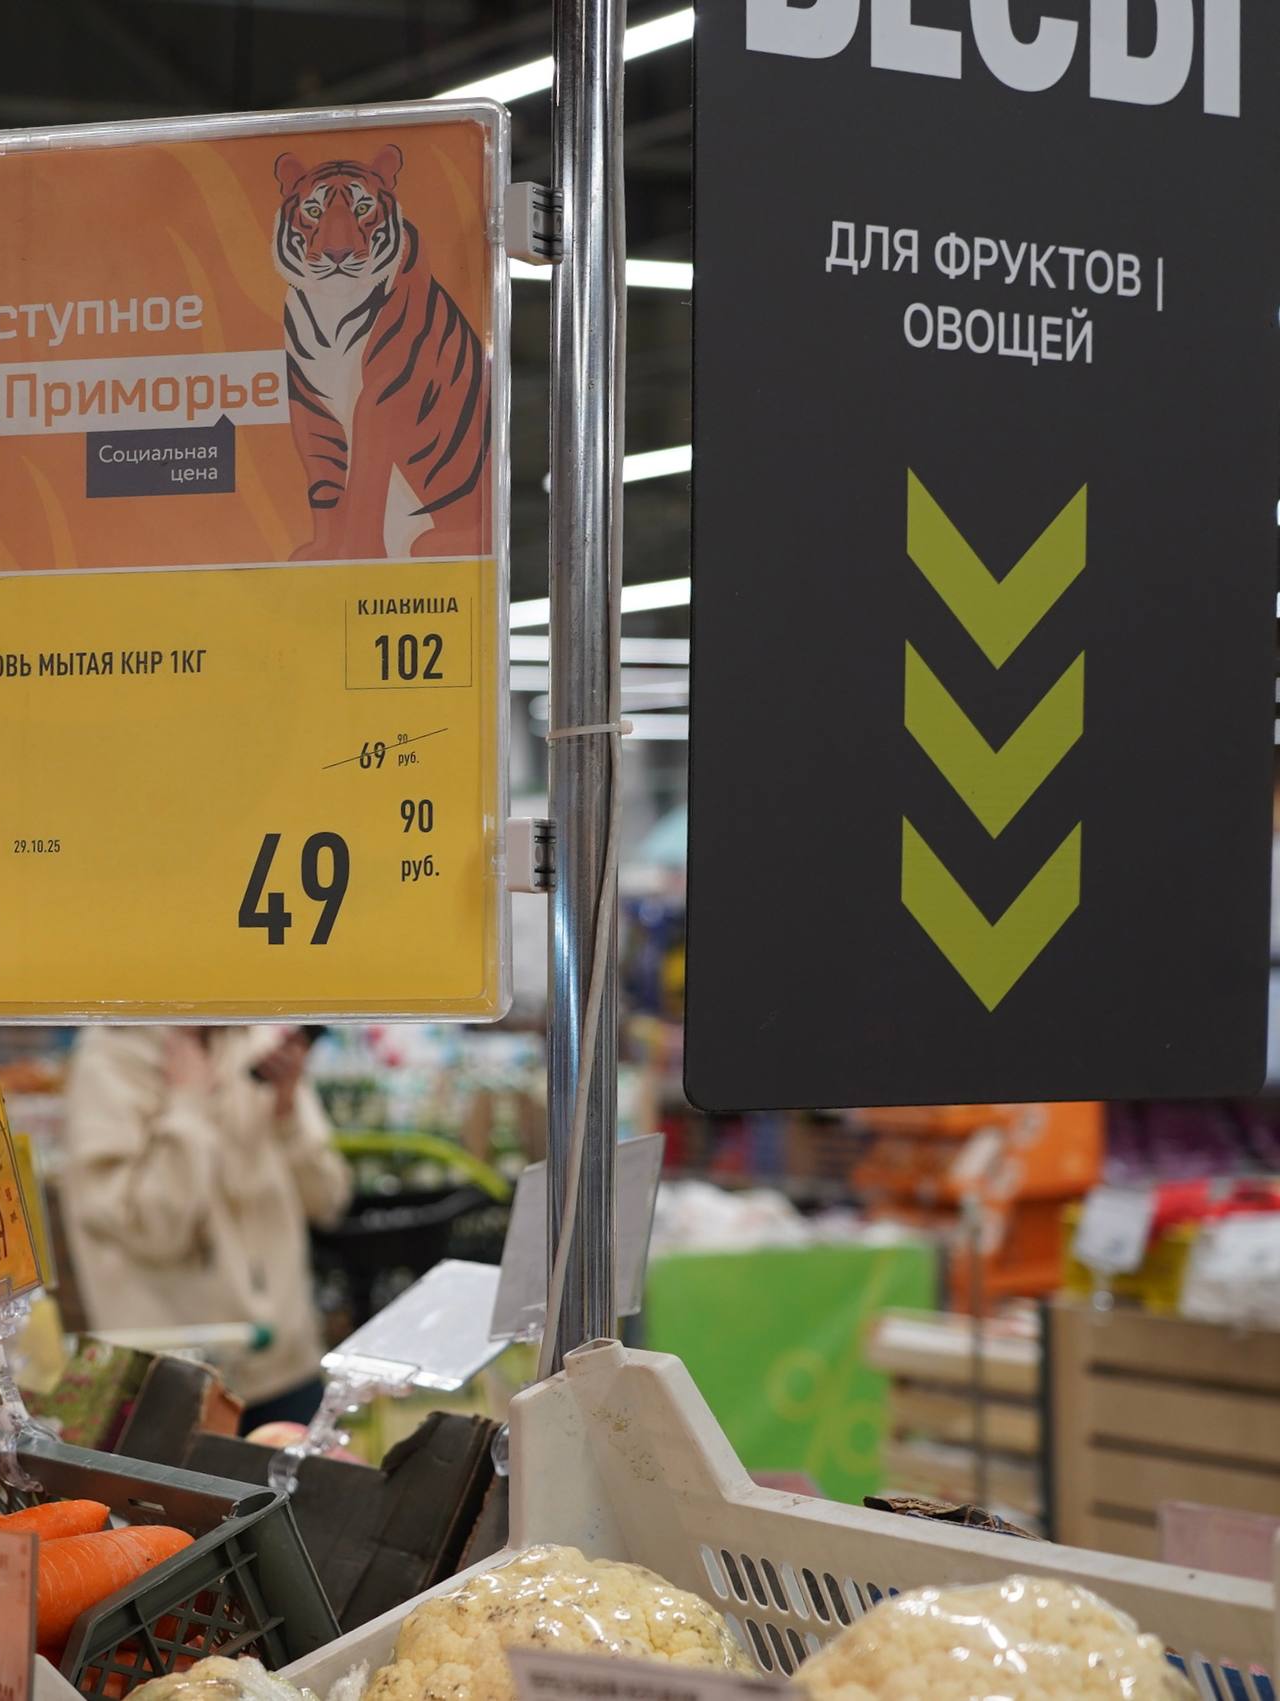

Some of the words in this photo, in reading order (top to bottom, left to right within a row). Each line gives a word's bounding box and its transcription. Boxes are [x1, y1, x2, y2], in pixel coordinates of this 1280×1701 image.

[826, 220, 919, 275] ДЛЯ
[934, 232, 1142, 297] ФРУКТОВ
[903, 302, 1093, 366] ОВОЩЕЙ
[6, 371, 281, 427] Приморье
[98, 443, 218, 464] Социальная
[170, 466, 218, 484] цена
[357, 597, 459, 616] КЛАВИША
[38, 651, 114, 677] МЫТАЯ
[121, 650, 164, 675] КНР
[170, 649, 207, 674] 1КГ
[375, 633, 444, 681] 102
[359, 741, 386, 769] 69
[398, 751, 420, 767] руб.
[400, 799, 434, 833] 90
[13, 839, 61, 854] 29.10.25
[401, 855, 440, 882] руб.
[238, 831, 350, 946] 49
